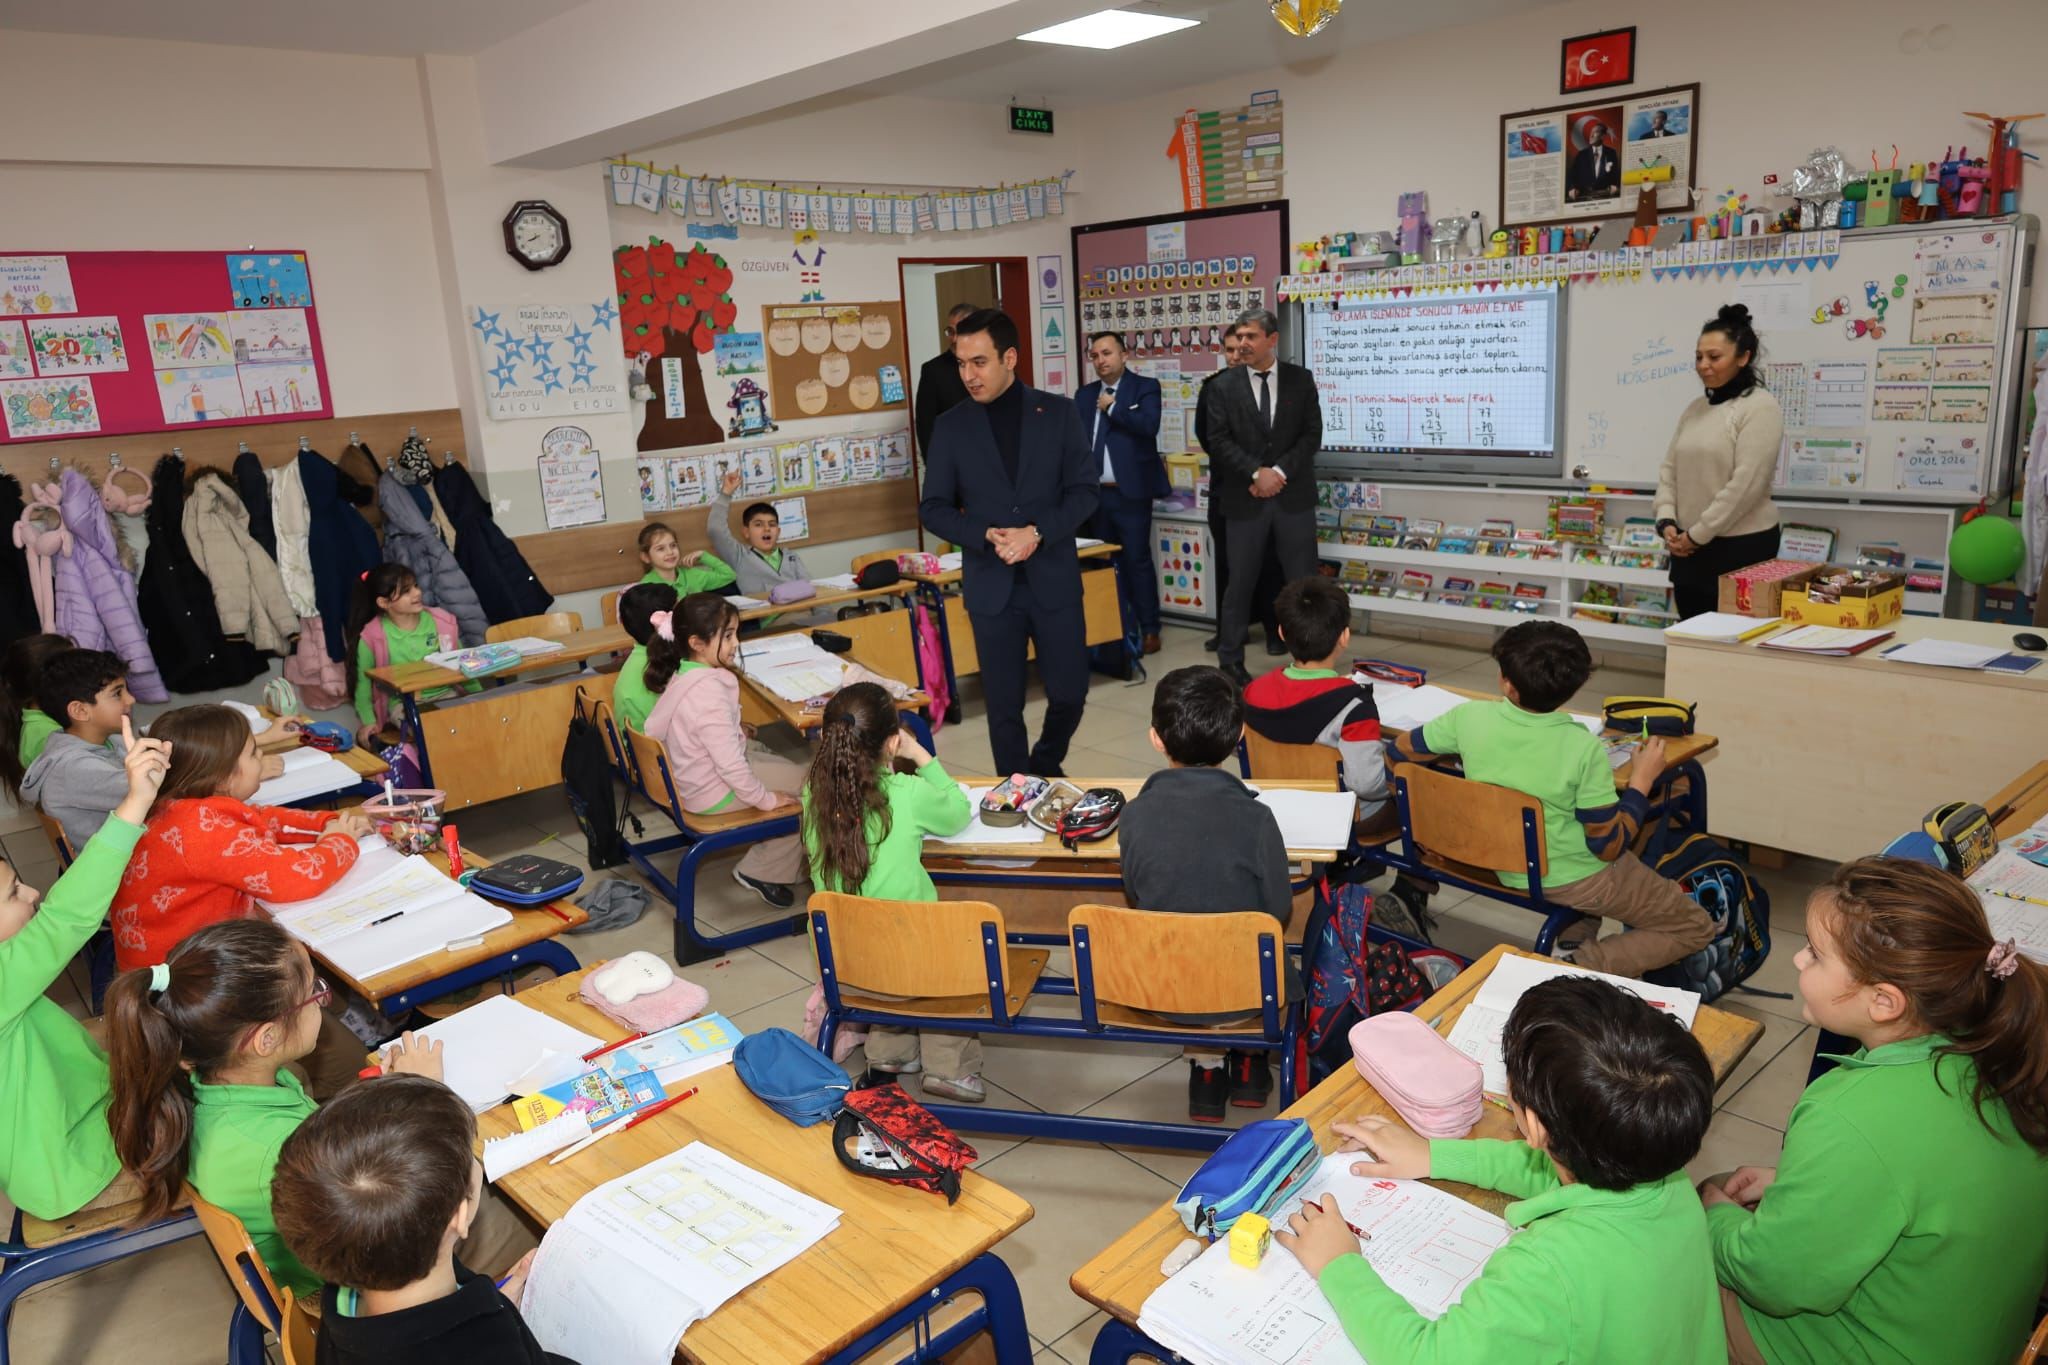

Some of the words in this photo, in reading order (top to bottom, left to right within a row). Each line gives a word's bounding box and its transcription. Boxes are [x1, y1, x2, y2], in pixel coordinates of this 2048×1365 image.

[1018, 109, 1045, 119] EXIT
[741, 259, 790, 272] ÖZGÜVEN
[1323, 326, 1358, 338] Toplama
[1406, 323, 1436, 332] sonucu
[1324, 339, 1359, 351] Toplanan
[1400, 340, 1411, 348] en
[1325, 352, 1344, 363] Daha
[1348, 353, 1370, 363] sonra
[1373, 353, 1384, 362] bu
[1371, 365, 1400, 376] tahmin
[1404, 367, 1435, 375] sonucu
[1369, 407, 1383, 418] 50
[1478, 408, 1491, 418] 77
[1333, 483, 1350, 509] 3
[1350, 484, 1365, 509] 4
